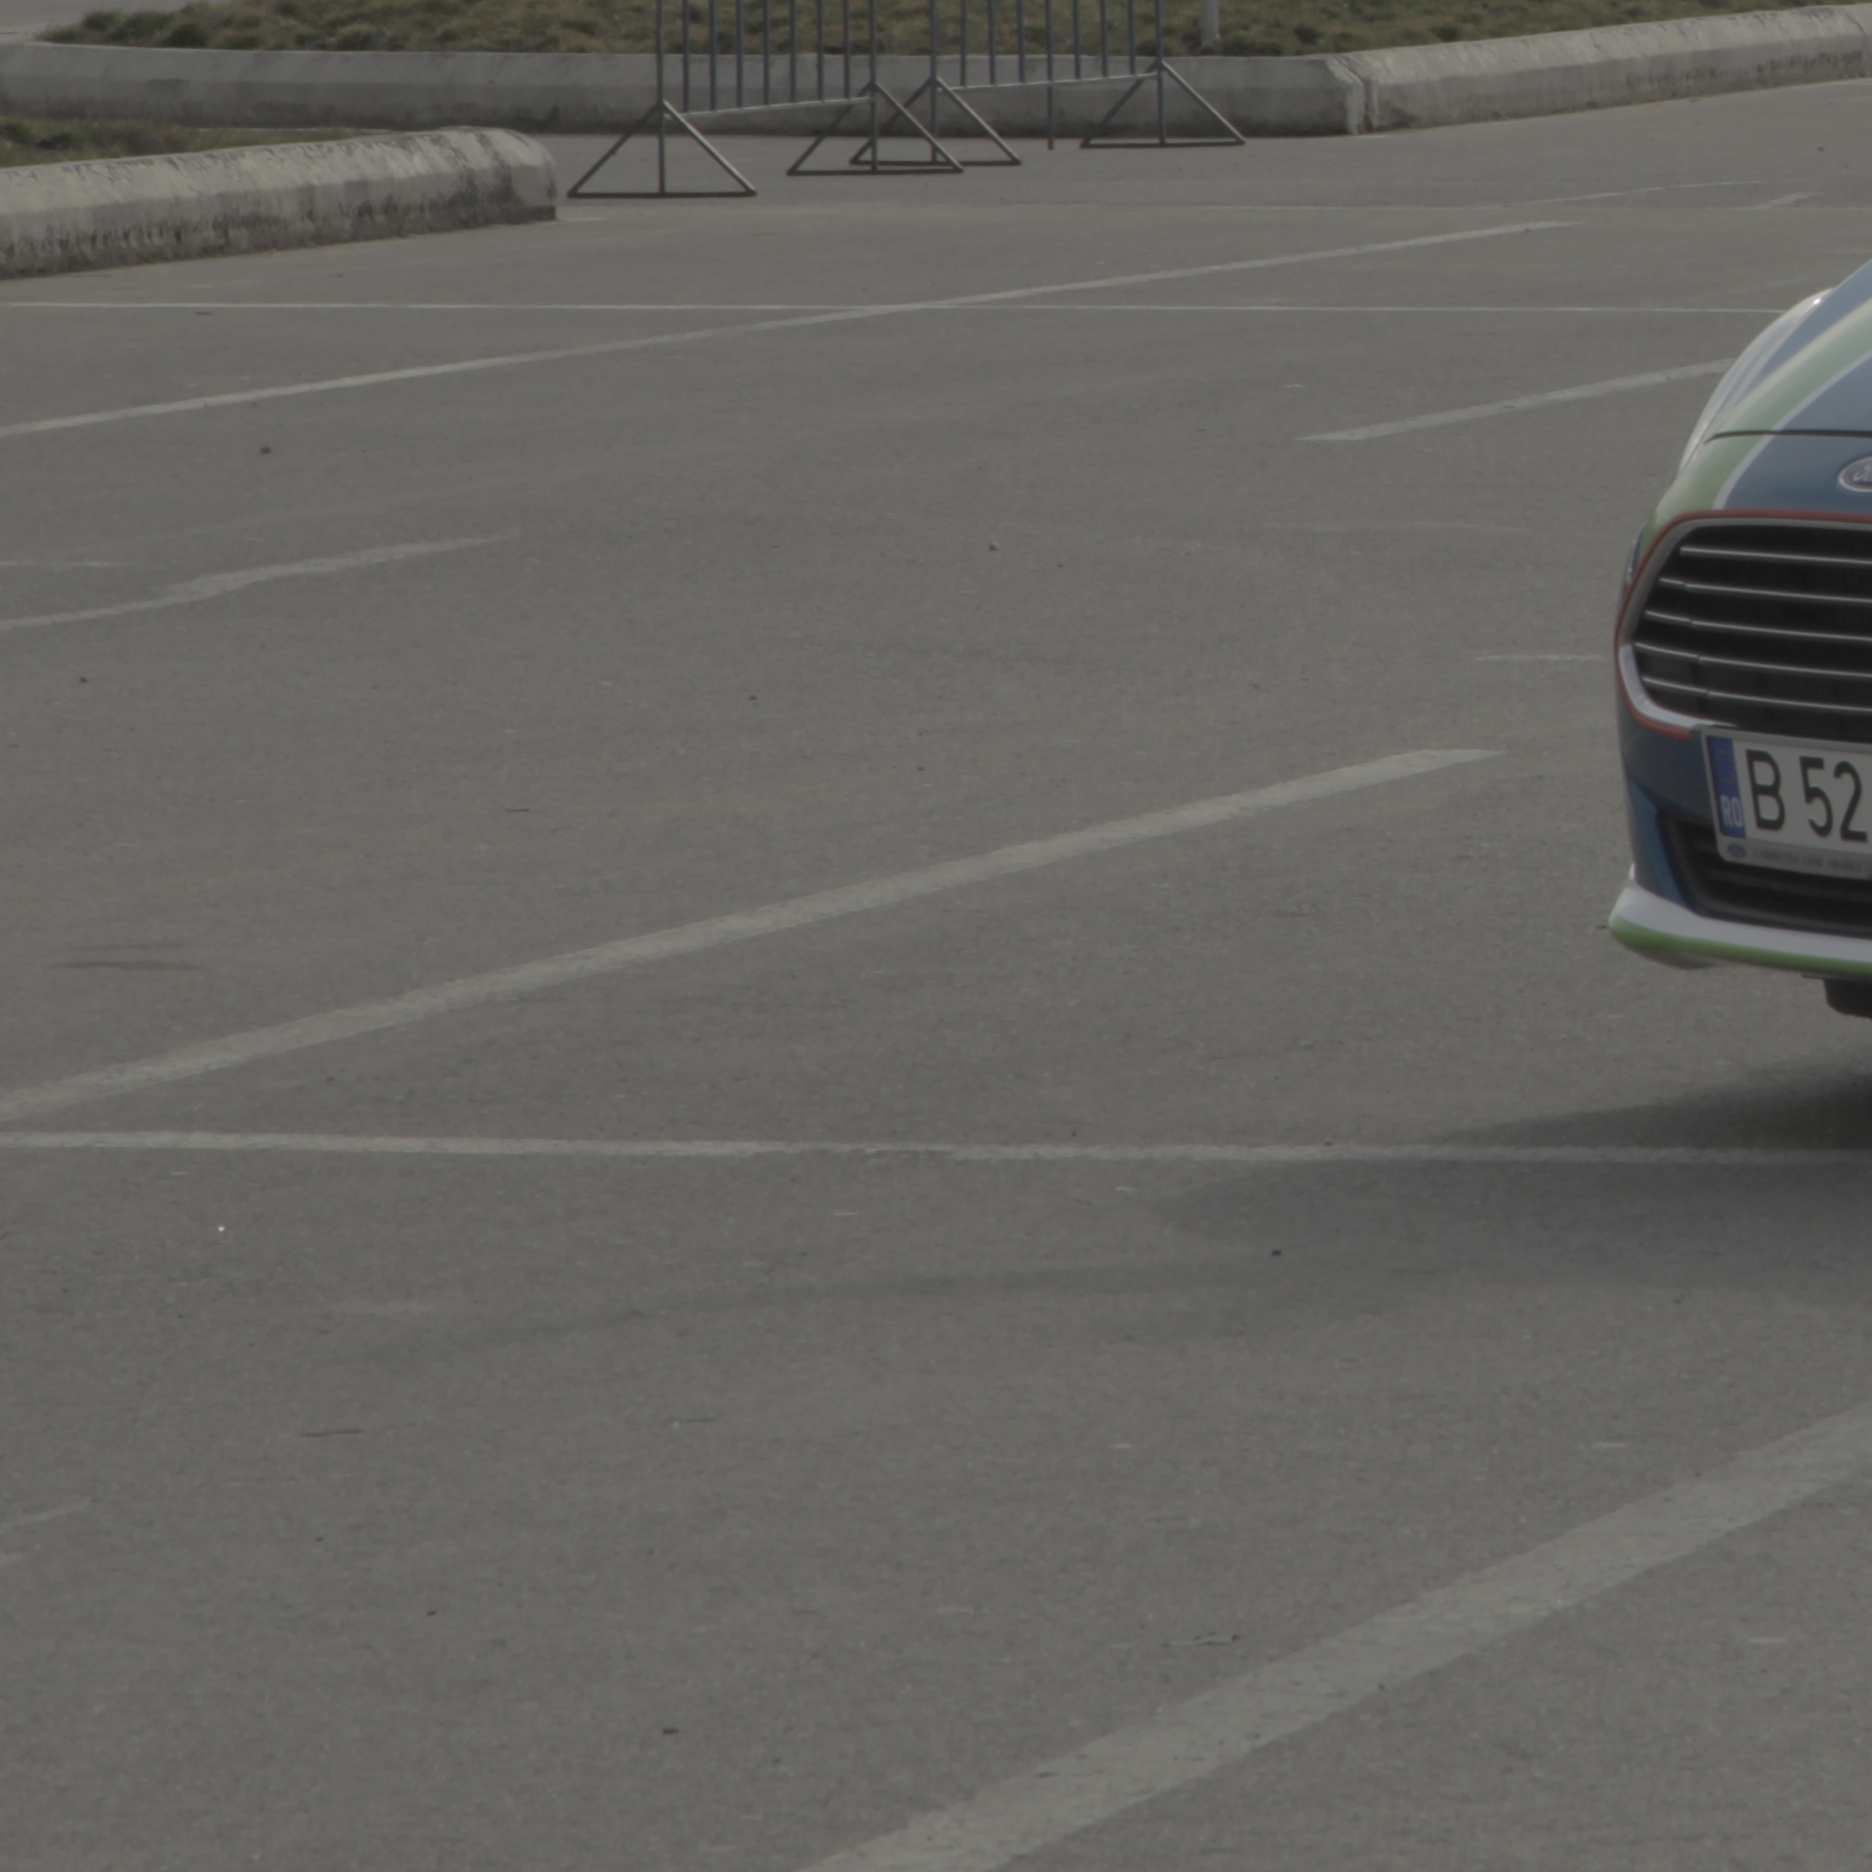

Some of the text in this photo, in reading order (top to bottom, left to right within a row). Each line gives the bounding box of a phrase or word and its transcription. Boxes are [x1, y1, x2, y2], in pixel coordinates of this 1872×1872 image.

[1720, 796, 1743, 828] RO
[1745, 749, 1785, 831] B
[1799, 756, 1868, 843] 52
